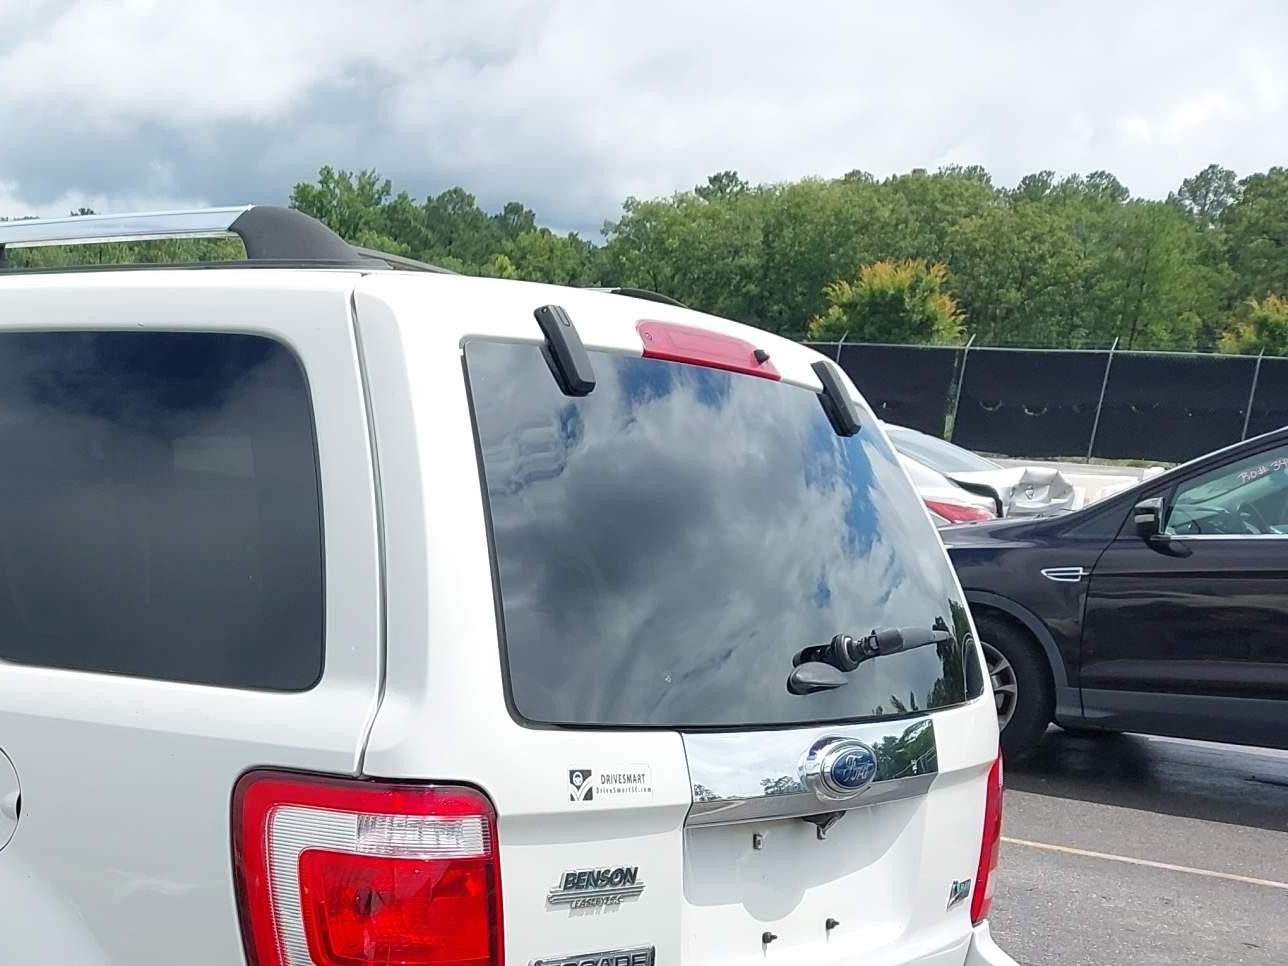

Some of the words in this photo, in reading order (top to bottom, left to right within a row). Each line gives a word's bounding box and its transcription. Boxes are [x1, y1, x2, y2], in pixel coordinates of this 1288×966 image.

[600, 773, 647, 785] DRIVESMART
[842, 755, 874, 783] Ford
[562, 866, 638, 891] BENSON
